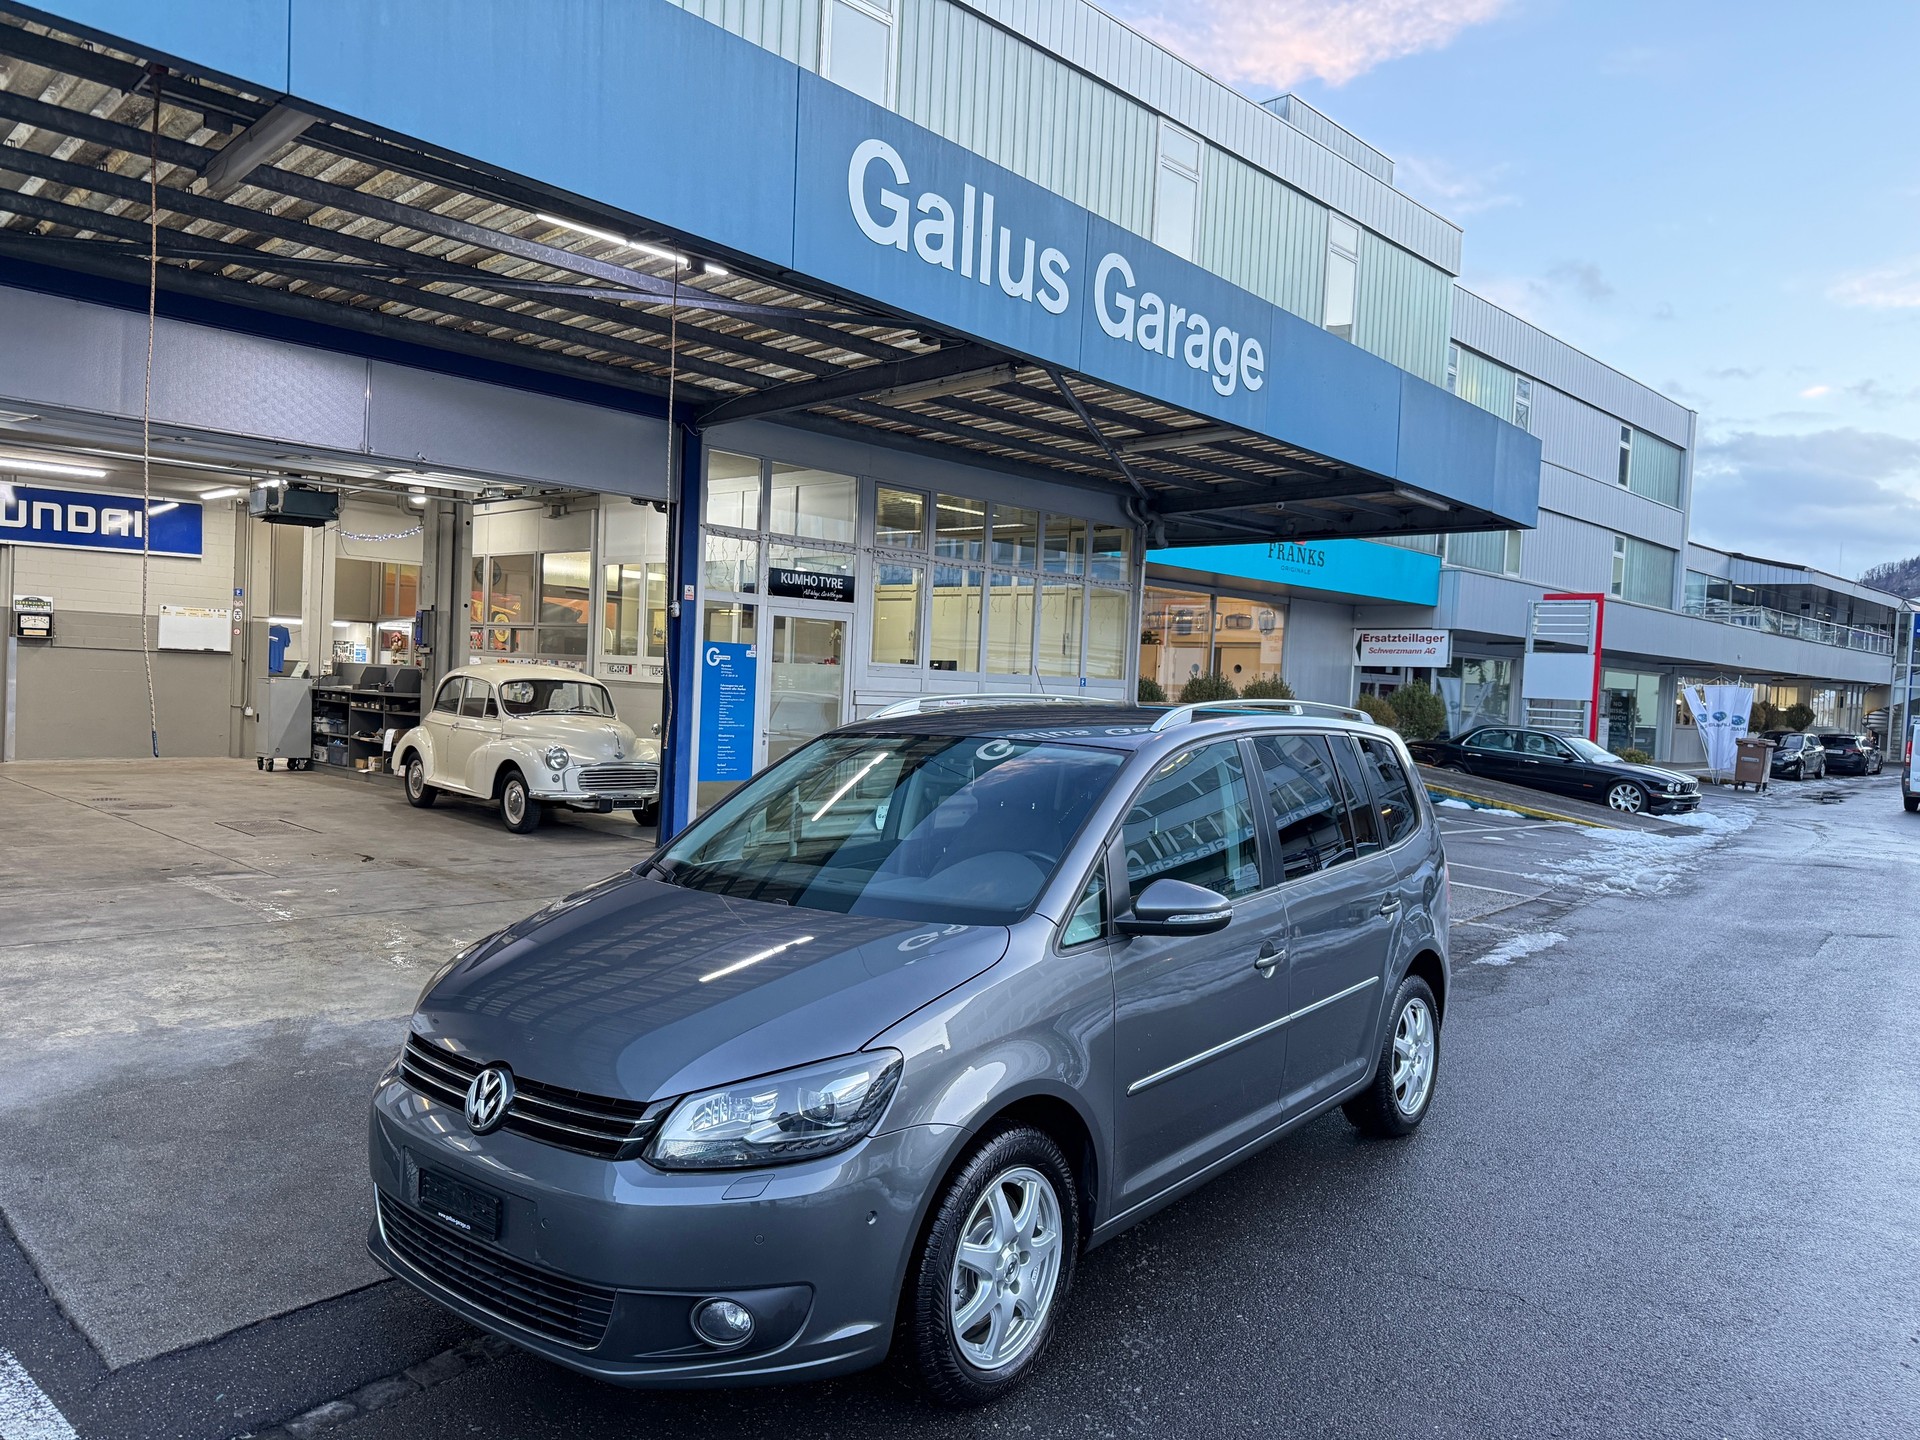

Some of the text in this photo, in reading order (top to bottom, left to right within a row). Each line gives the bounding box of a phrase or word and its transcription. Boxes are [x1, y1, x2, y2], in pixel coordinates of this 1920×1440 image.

[848, 138, 1265, 397] Gallus Garage
[1268, 543, 1325, 567] FRANKS
[1280, 565, 1311, 575] ORIGINALE
[781, 572, 844, 589] KUMHO TYRE
[1362, 633, 1445, 645] Ersatzteillager
[1368, 647, 1437, 655] Schwerzmann AG
